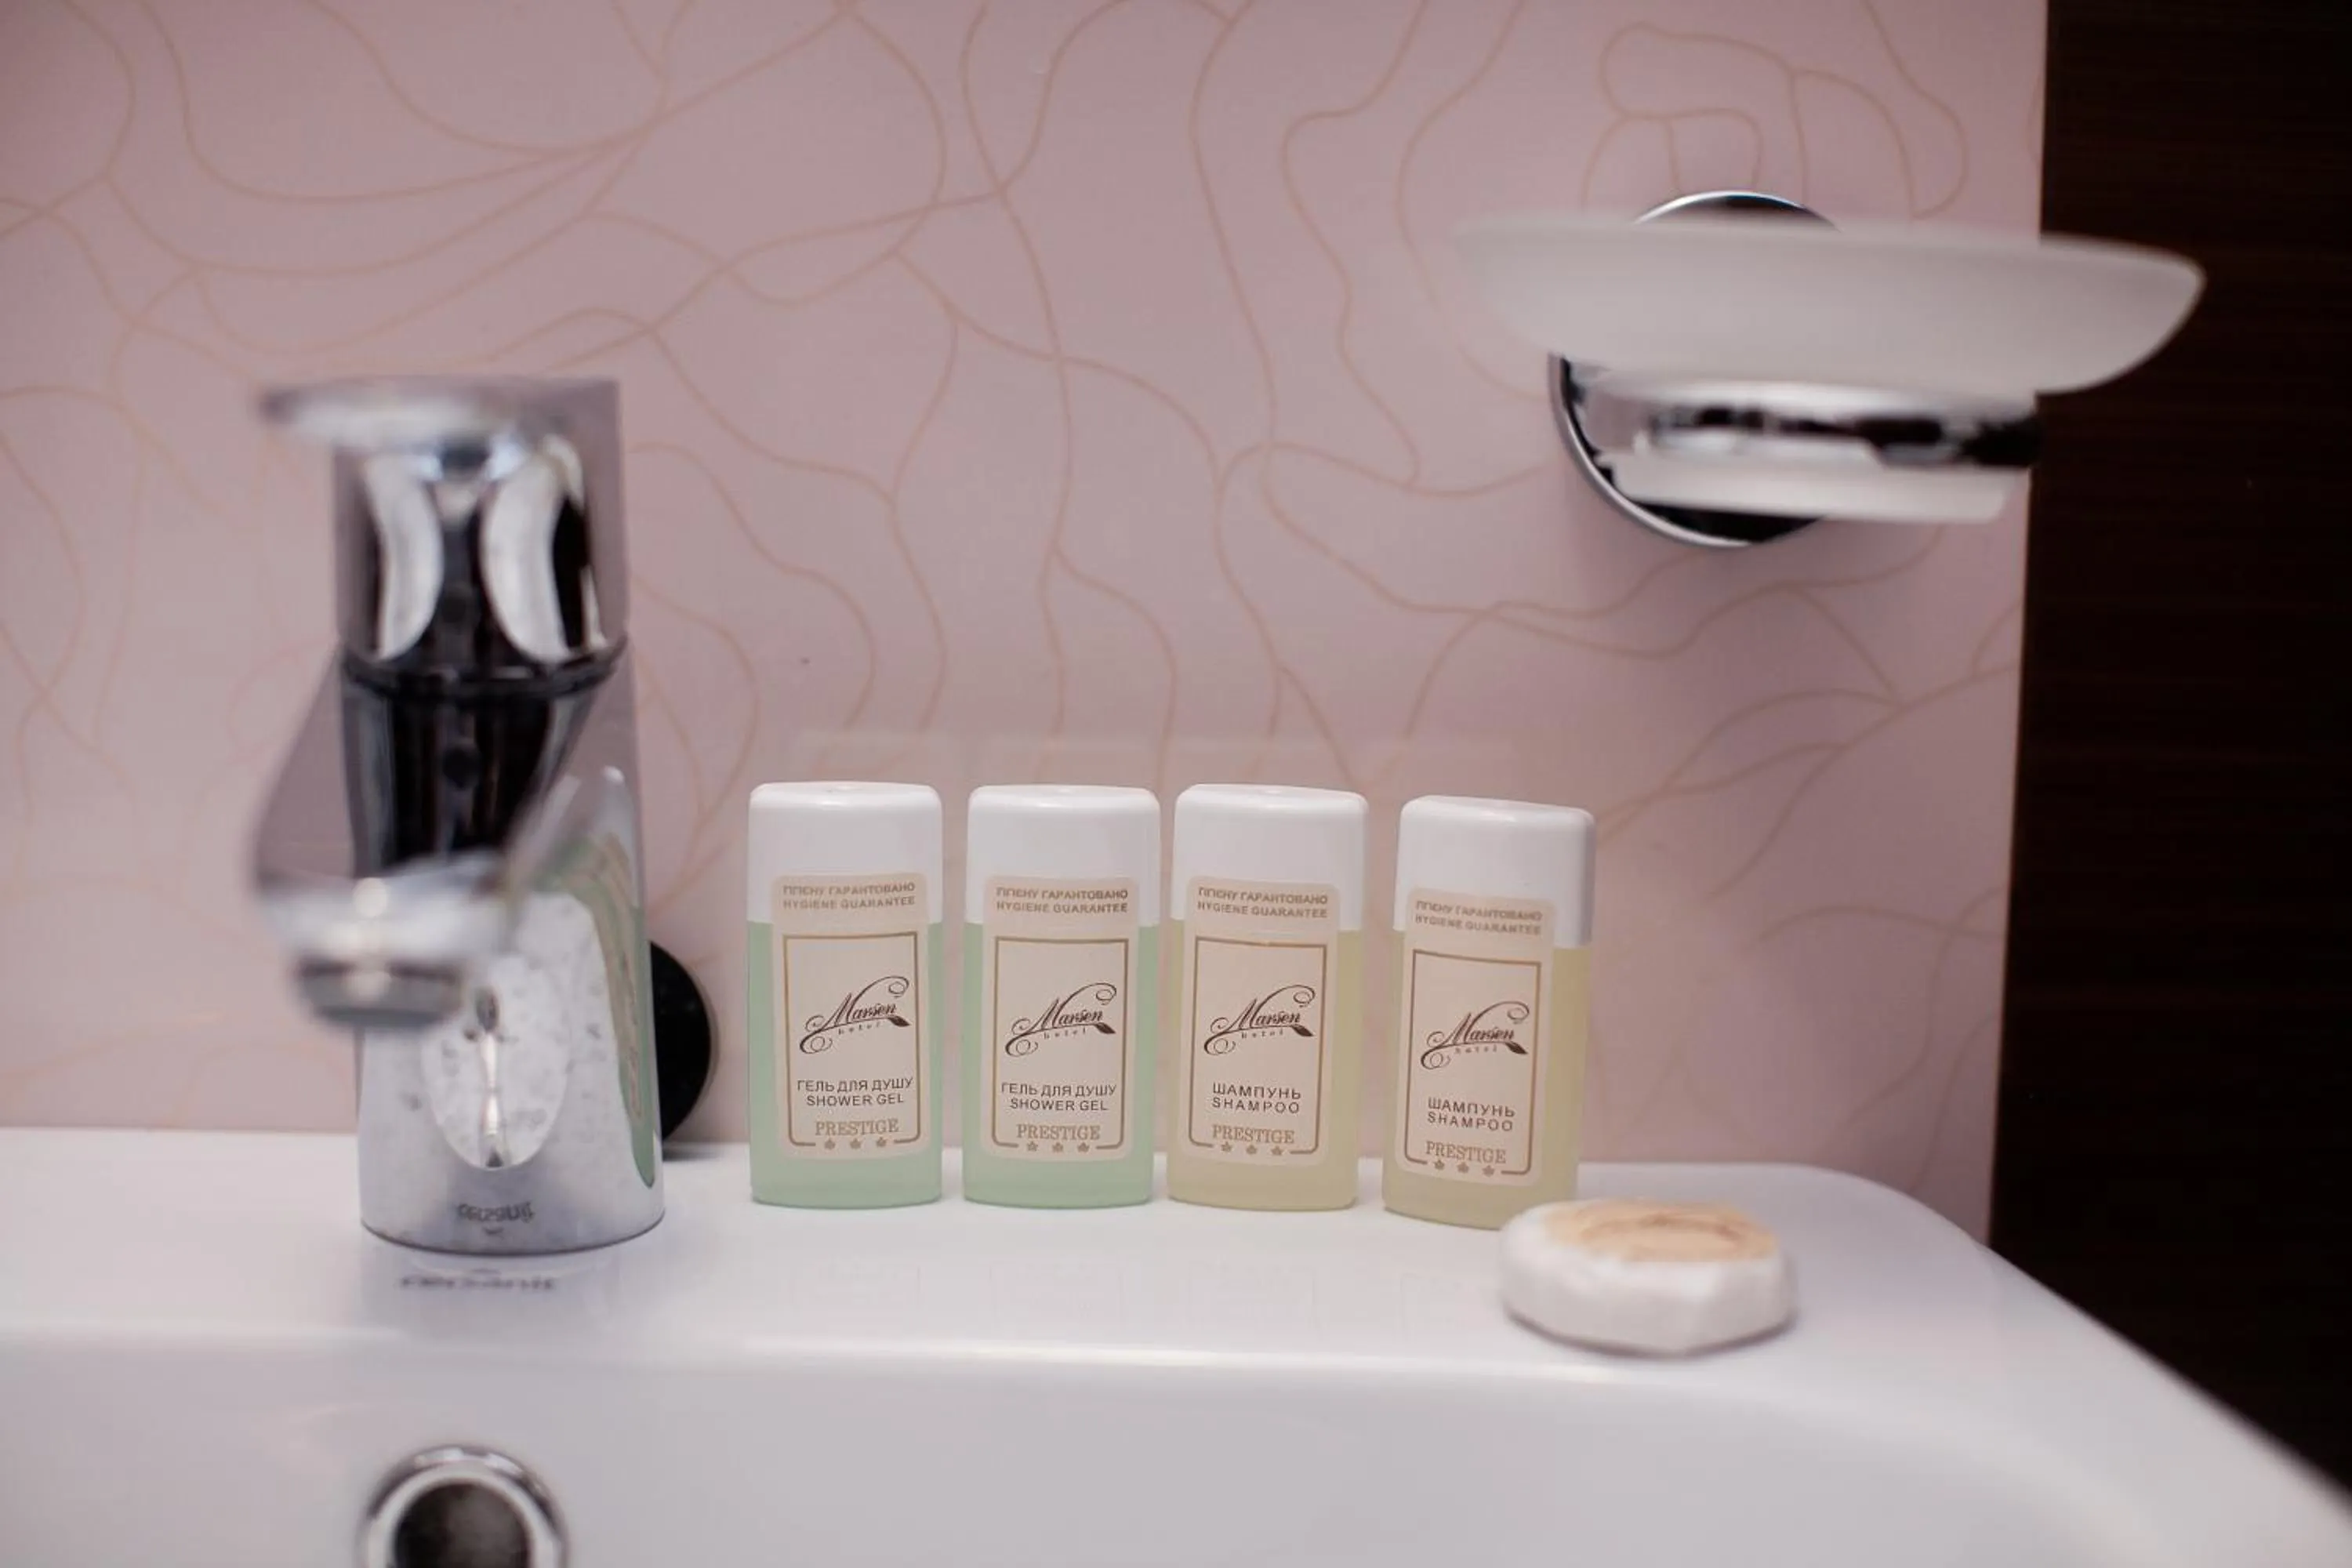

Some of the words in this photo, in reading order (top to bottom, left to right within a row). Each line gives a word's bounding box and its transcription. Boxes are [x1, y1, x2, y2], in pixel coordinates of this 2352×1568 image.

[784, 898, 837, 909] HYGIENE
[840, 896, 915, 909] GUARANTEE
[996, 902, 1049, 913] HYGIENE
[1053, 902, 1128, 914] GUARANTEE
[1197, 901, 1248, 915] HYGIENE
[1250, 906, 1327, 919] GUARANTEE
[1415, 914, 1462, 930] HYGIENE
[1465, 921, 1541, 936] GUARANTEE
[797, 1080, 834, 1092] ГЕЛЬ
[837, 1080, 869, 1093] ДЛЯ
[871, 1076, 913, 1092] ДУШУ
[1001, 1082, 1038, 1095] ГЕЛЬ
[1040, 1084, 1072, 1097] ДЛЯ
[1075, 1084, 1116, 1097] ДУШУ
[1213, 1082, 1301, 1100] ШАМПУНЬ
[806, 1094, 873, 1106] SHOWER
[876, 1093, 905, 1105] GEL
[1010, 1098, 1075, 1111] SHOWER
[1079, 1100, 1109, 1111] GEL
[1212, 1097, 1300, 1114] SHAMPOO
[1428, 1097, 1515, 1118] ШАМПУНЬ
[815, 1118, 899, 1135] PRESTIGE
[1427, 1111, 1514, 1131] SHAMPOO
[1016, 1123, 1101, 1140] PRESTIGE
[1212, 1123, 1295, 1145] PRESTIGE
[1425, 1141, 1507, 1164] PRESTIGE
